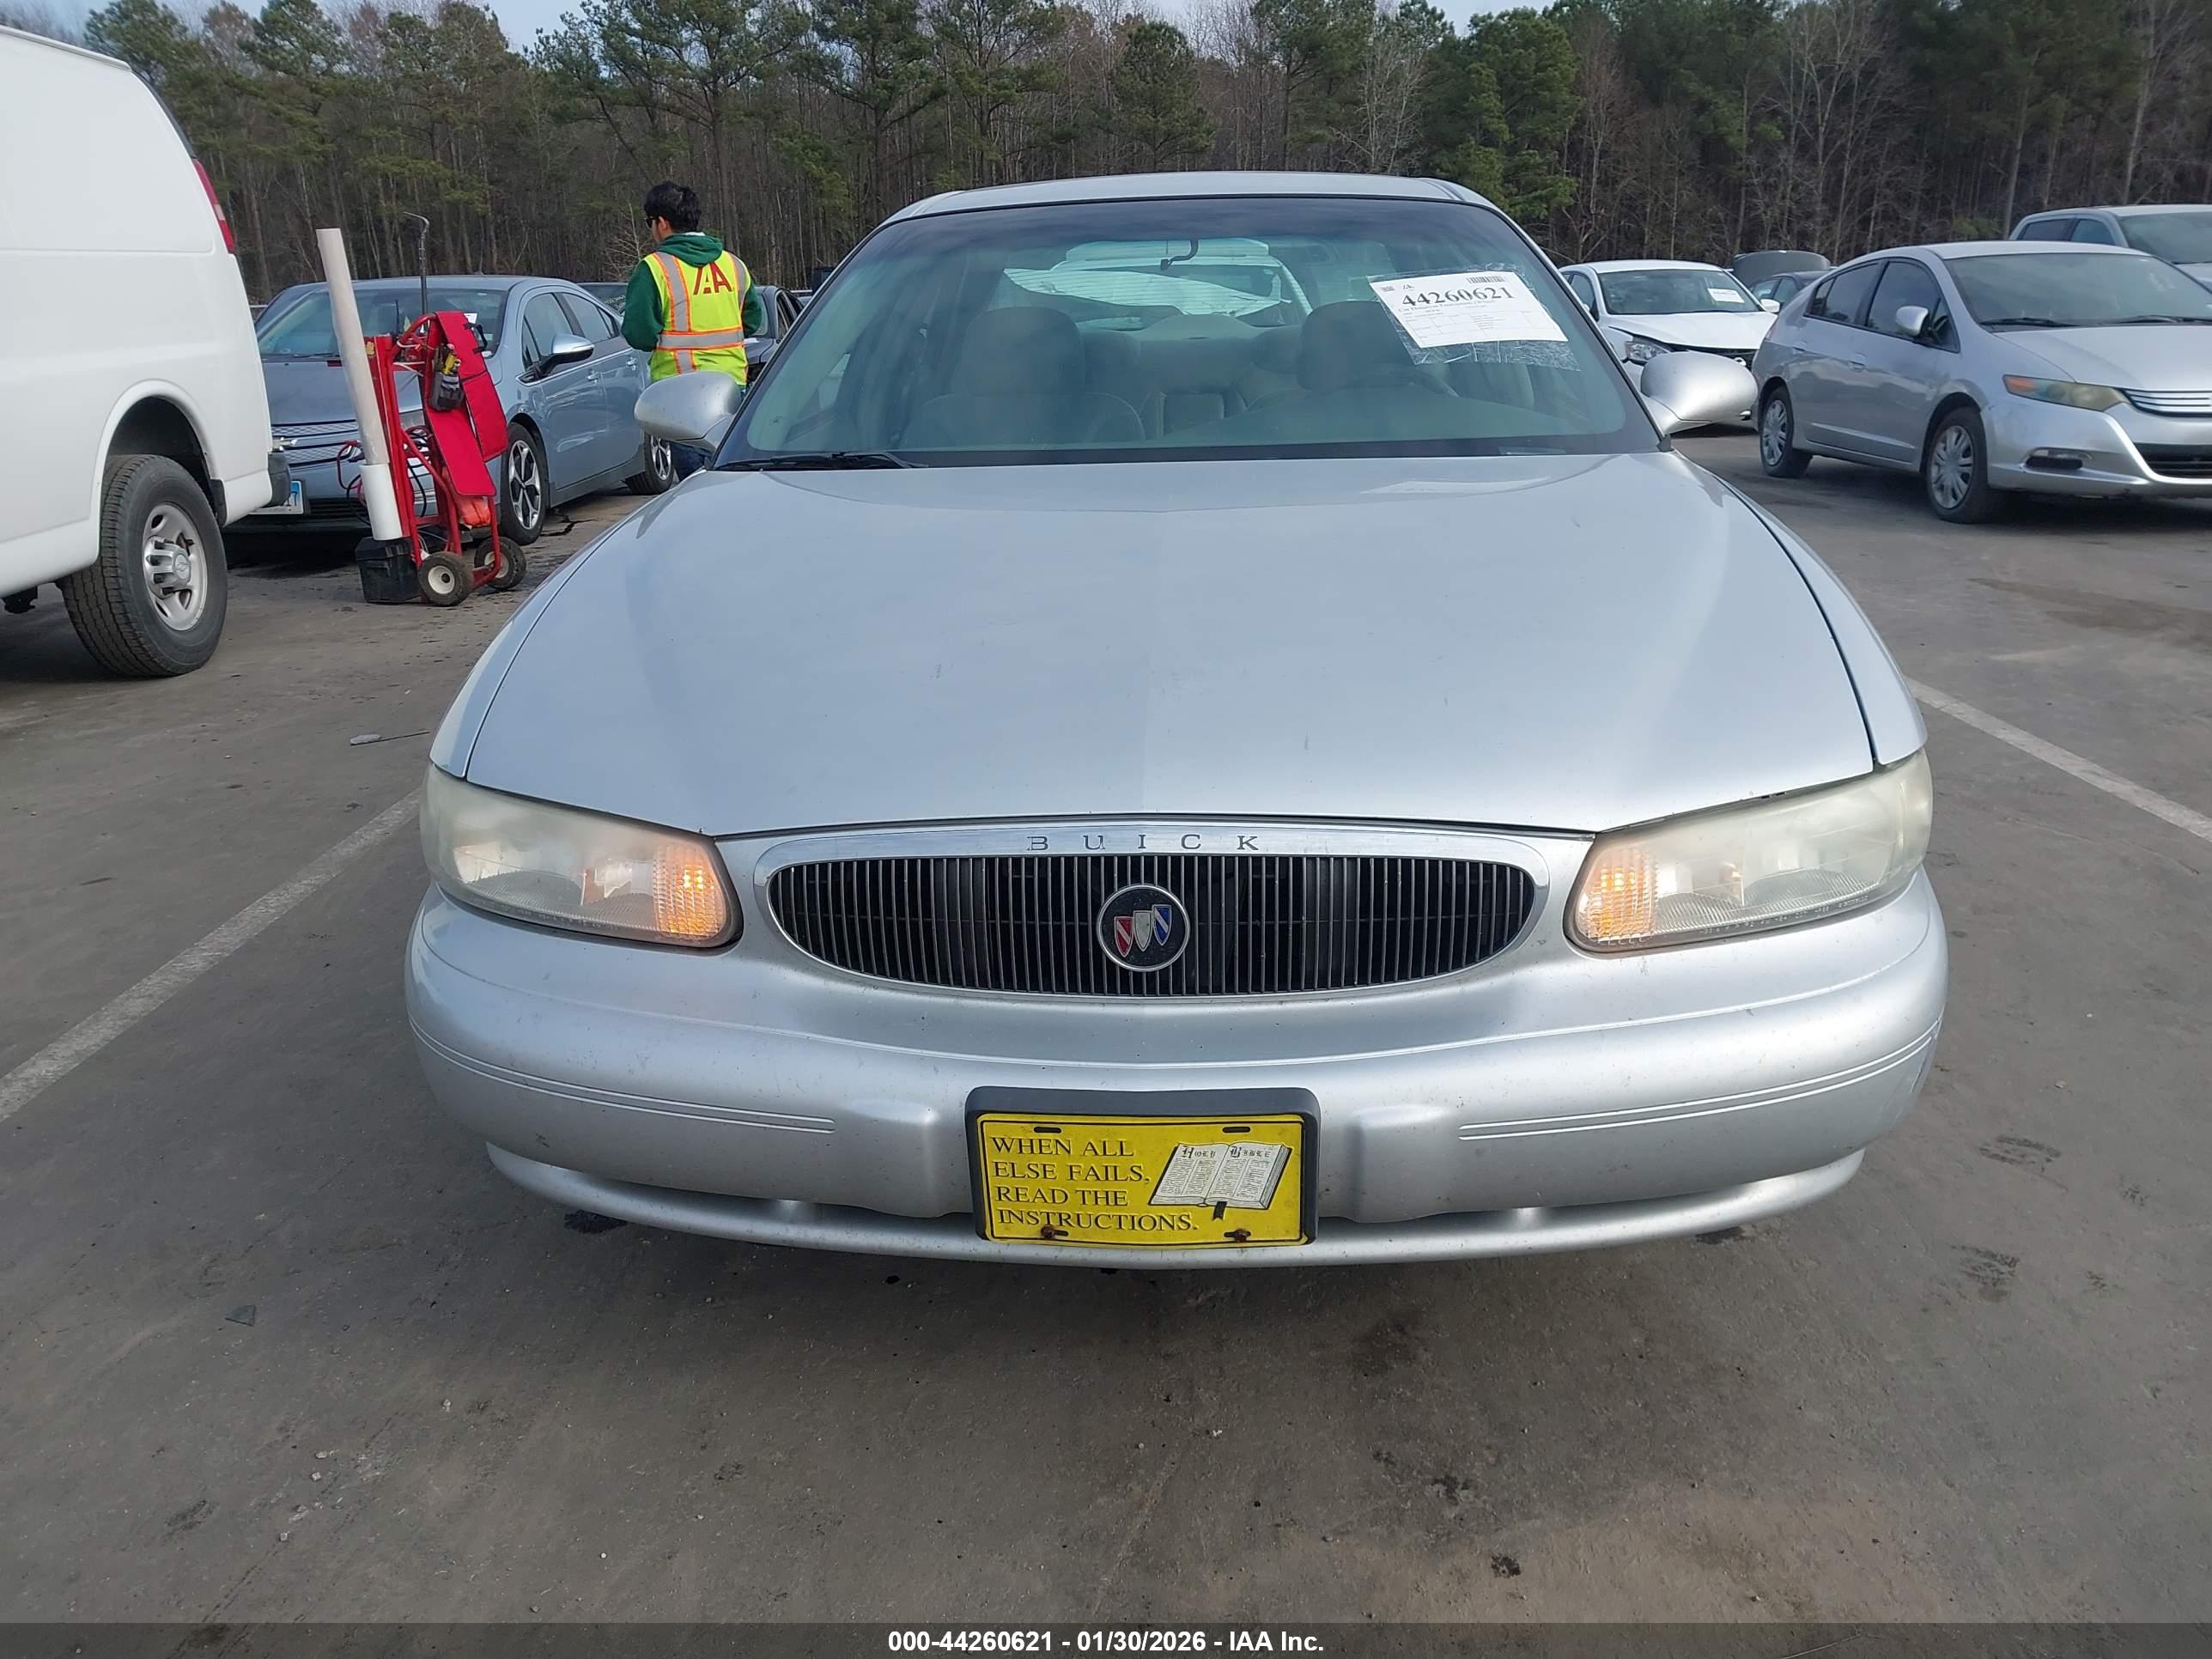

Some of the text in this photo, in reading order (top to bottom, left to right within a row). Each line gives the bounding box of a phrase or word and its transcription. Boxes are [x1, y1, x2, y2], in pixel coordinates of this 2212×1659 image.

[1402, 287, 1516, 307] 44260621
[1026, 834, 1259, 851] BUICK
[991, 1137, 1134, 1157] WHEN ALL
[993, 1161, 1057, 1180] ELSE
[1066, 1164, 1151, 1184] FAILS,
[996, 1186, 1128, 1206] READ THE
[998, 1208, 1198, 1231] INSTRUCTIONS.
